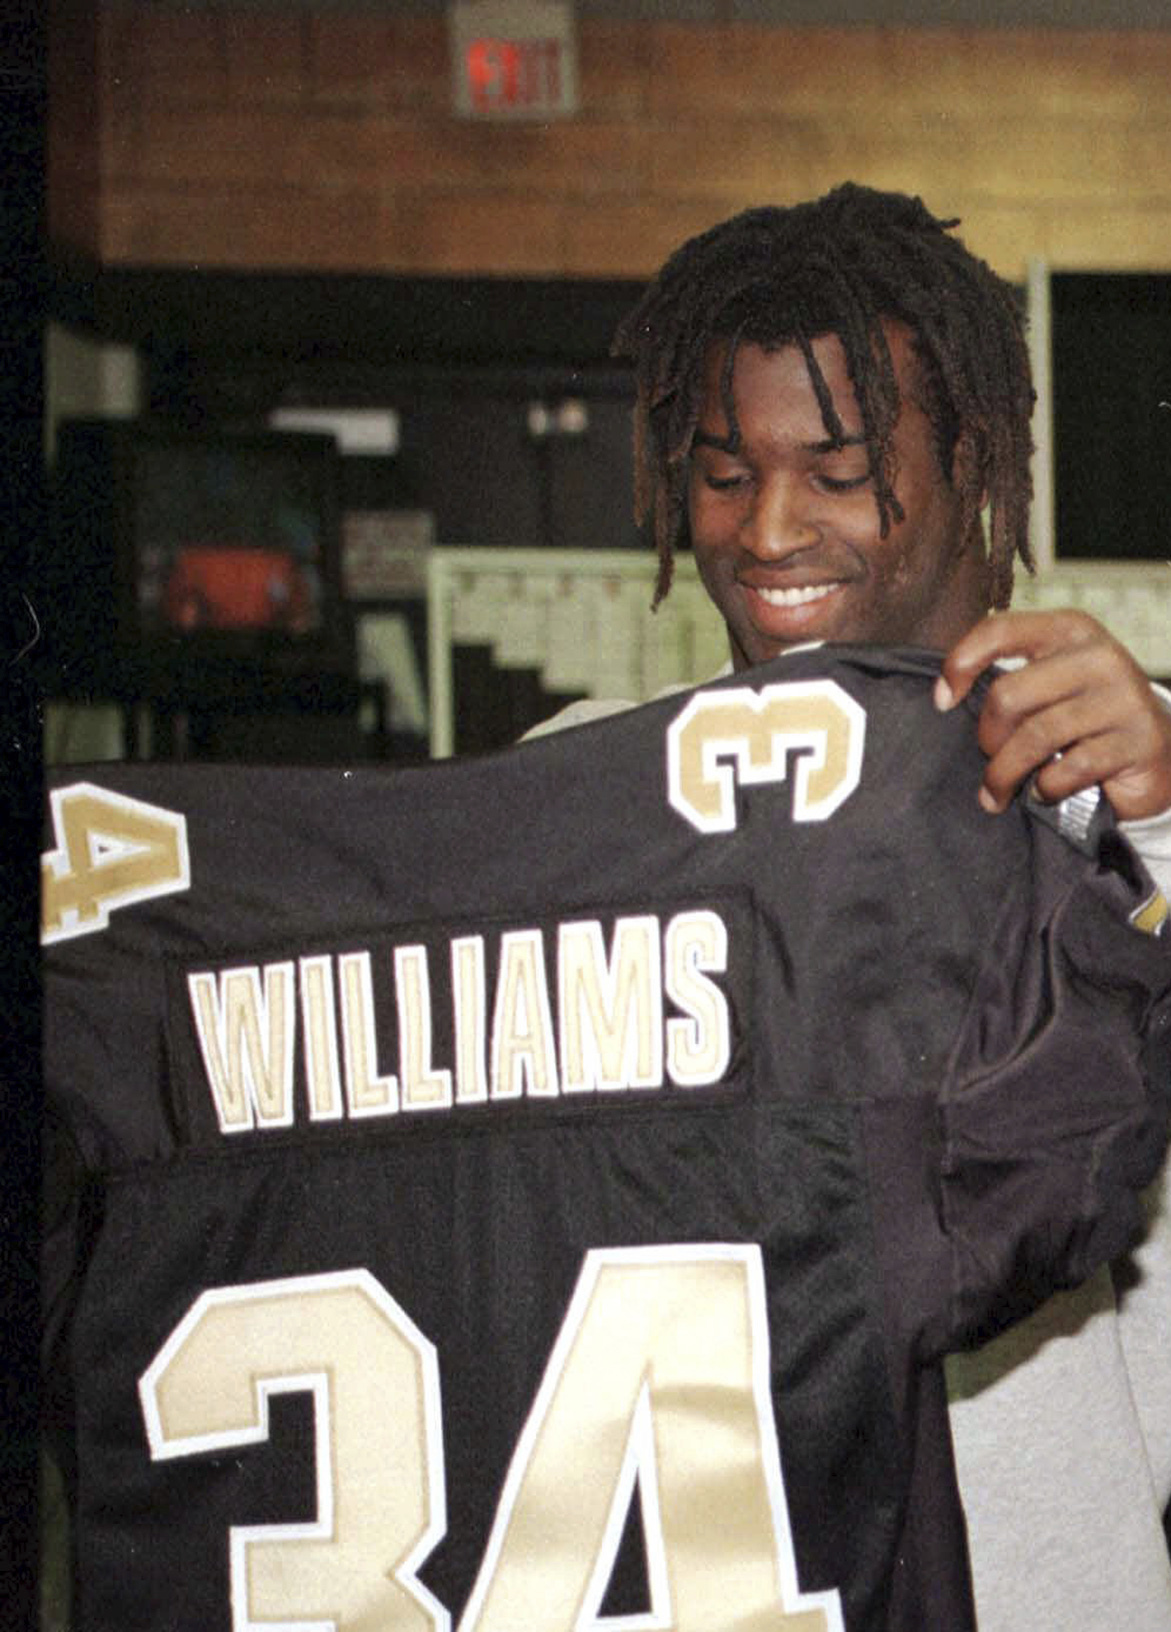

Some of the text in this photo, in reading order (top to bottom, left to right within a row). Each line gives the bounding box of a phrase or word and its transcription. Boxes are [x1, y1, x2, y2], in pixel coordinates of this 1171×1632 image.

[667, 680, 866, 832] 3
[42, 783, 190, 945] 4
[189, 910, 729, 1133] WILLIAMS
[139, 1243, 845, 1632] 34
